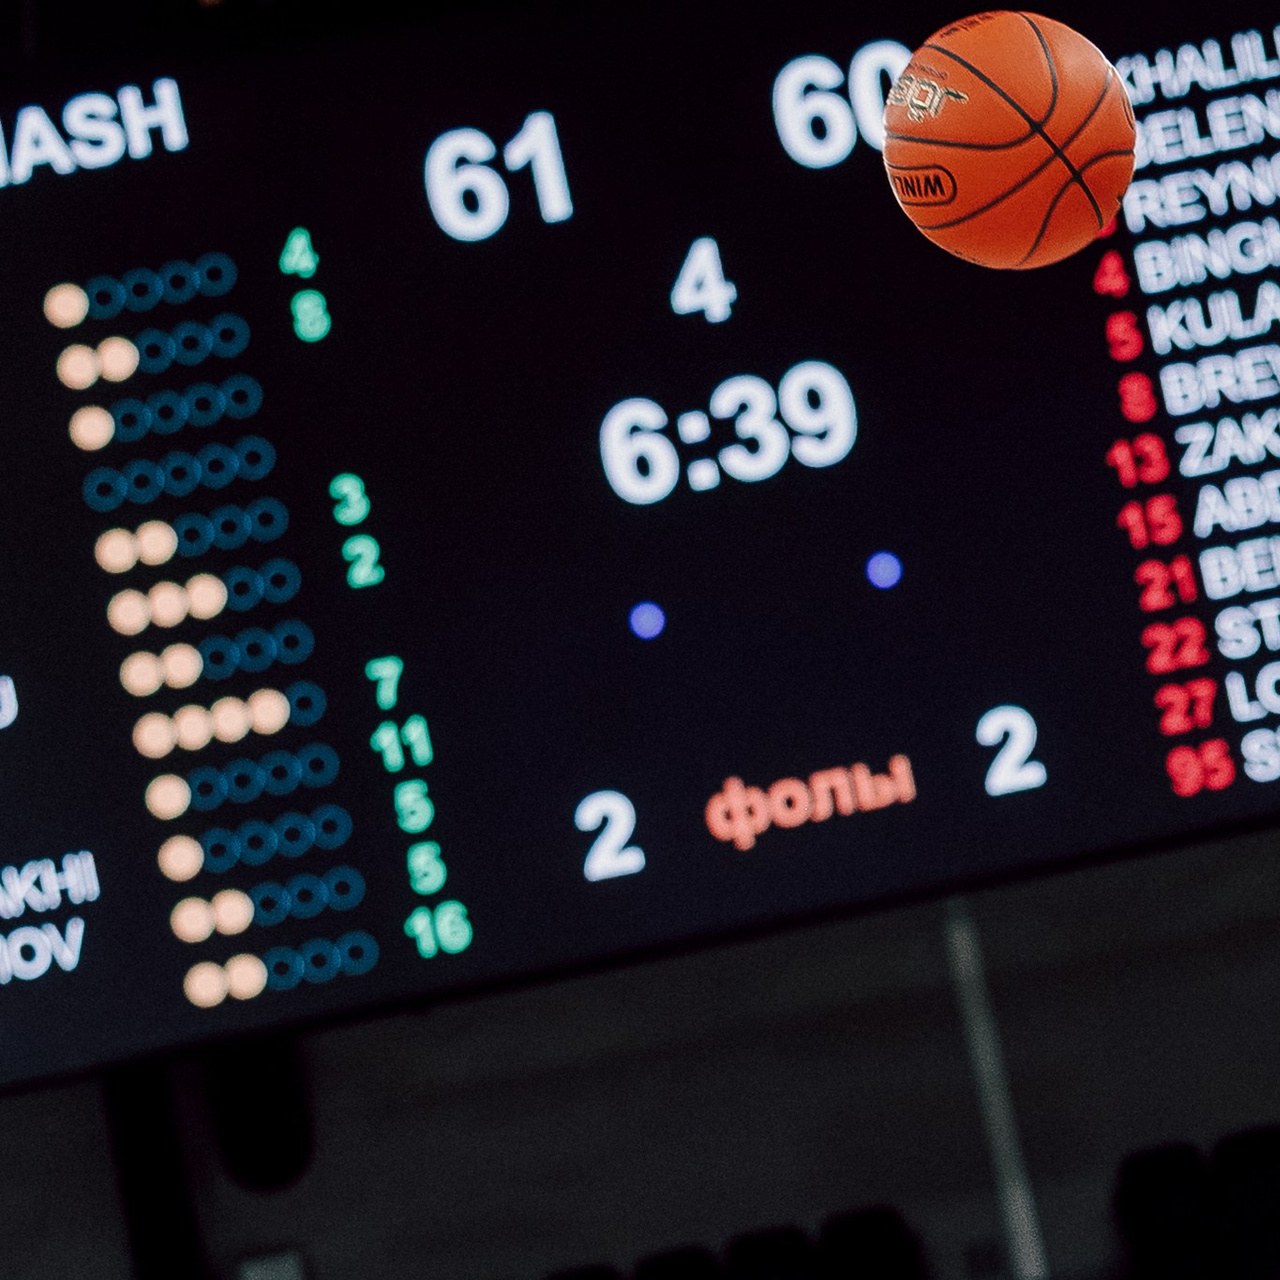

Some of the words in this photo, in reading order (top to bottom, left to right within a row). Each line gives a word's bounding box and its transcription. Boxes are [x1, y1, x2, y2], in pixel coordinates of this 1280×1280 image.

[771, 40, 913, 169] 60
[424, 111, 575, 241] 61
[278, 226, 320, 280] 4
[670, 237, 737, 324] 4
[598, 360, 858, 506] 6:39
[1105, 432, 1171, 488] 13
[328, 472, 371, 526] 3
[1116, 493, 1184, 550] 15
[341, 533, 386, 590] 2
[1134, 554, 1198, 613] 21
[1140, 616, 1210, 675] 22
[364, 655, 405, 711] 7
[1153, 676, 1218, 737] 27
[370, 714, 434, 773] 11
[975, 705, 1048, 797] 2
[394, 778, 436, 835] 5
[704, 754, 917, 851] фолы
[574, 790, 647, 883] 2
[407, 840, 448, 897] 5
[403, 899, 474, 960] 16
